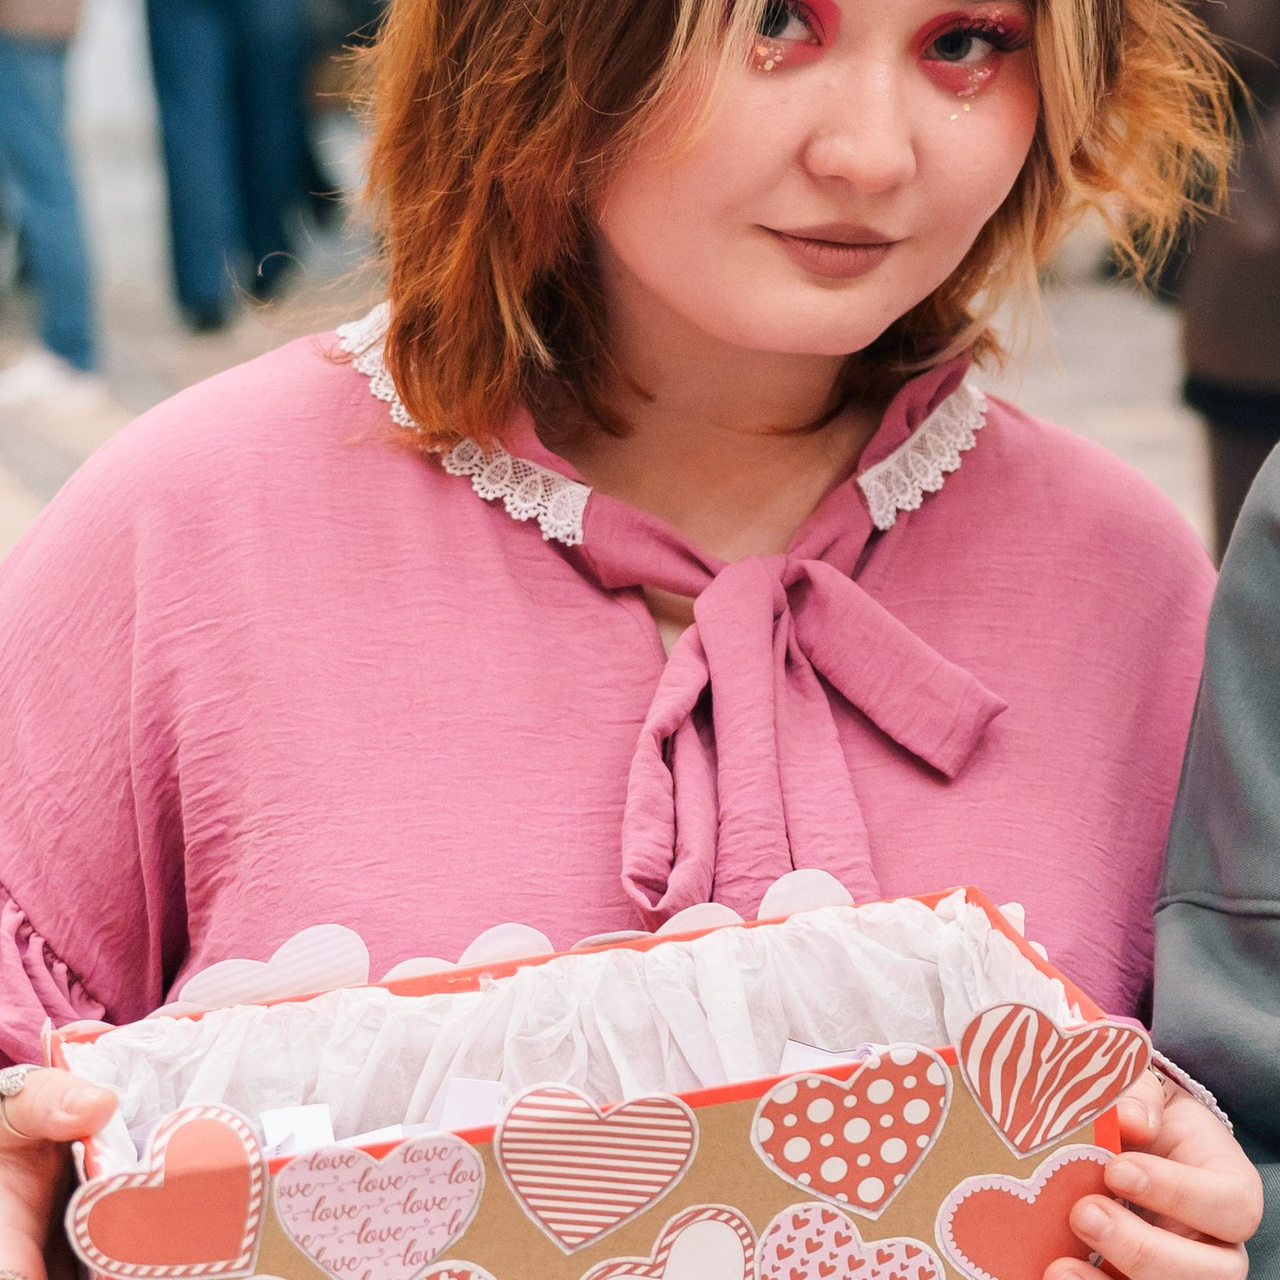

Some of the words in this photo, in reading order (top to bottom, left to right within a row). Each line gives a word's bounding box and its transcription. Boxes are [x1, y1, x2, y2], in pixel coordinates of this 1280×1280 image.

[308, 1150, 358, 1172] love
[402, 1144, 449, 1164] love
[279, 1182, 312, 1198] ove
[357, 1166, 403, 1193] love
[448, 1158, 480, 1185] lov
[311, 1194, 358, 1222] love
[402, 1187, 448, 1215] love
[357, 1217, 403, 1244] love
[402, 1238, 436, 1267] lov
